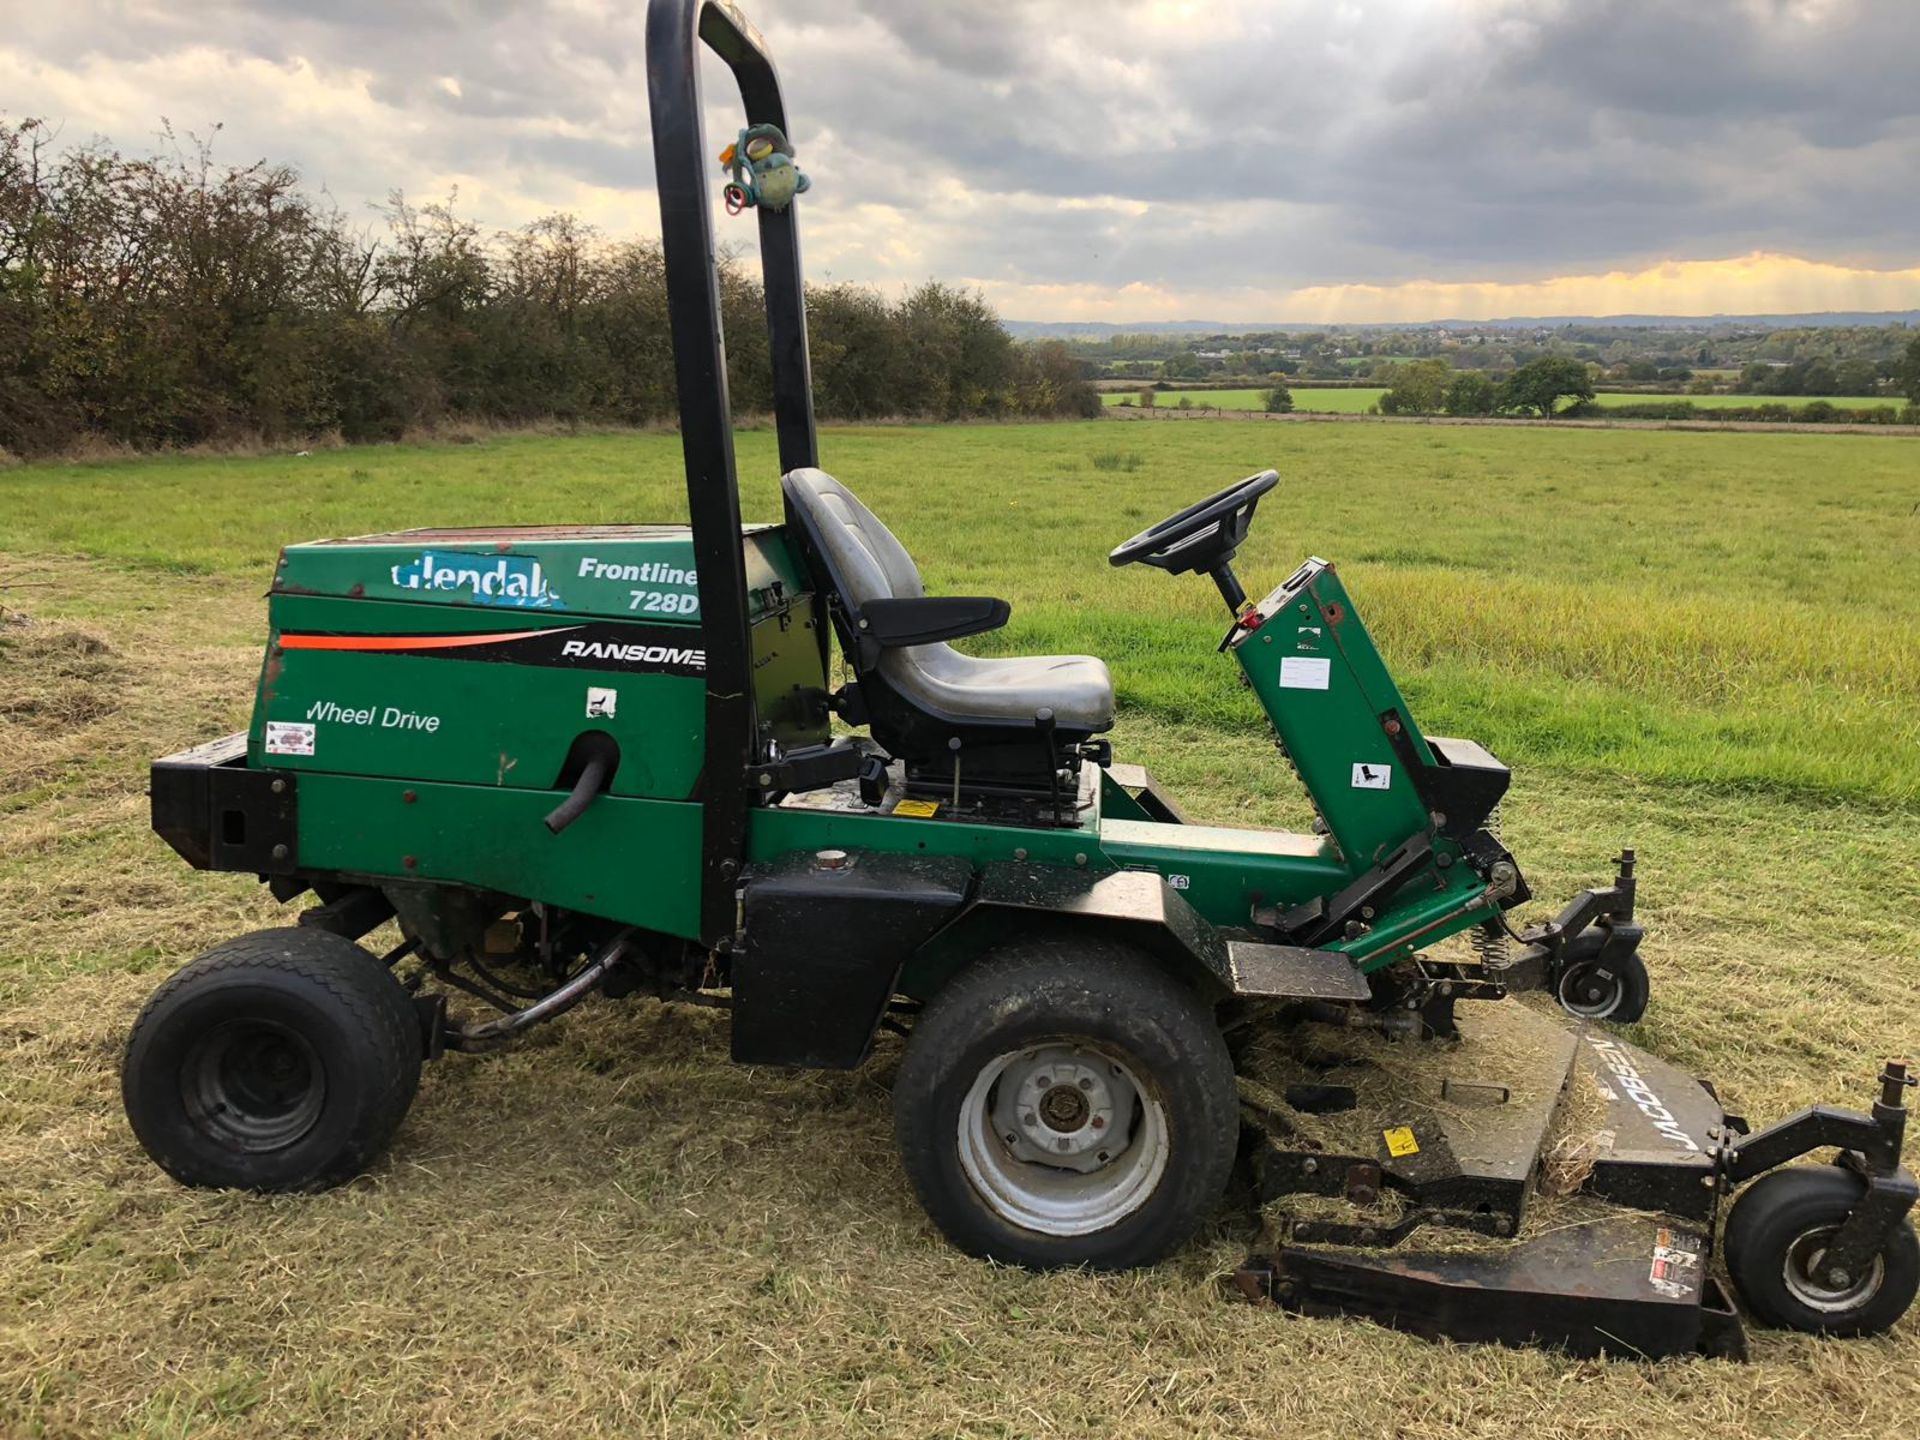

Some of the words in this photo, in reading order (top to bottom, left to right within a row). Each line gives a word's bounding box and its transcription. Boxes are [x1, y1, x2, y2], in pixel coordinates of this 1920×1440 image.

[578, 557, 698, 586] Frontline
[628, 590, 699, 614] 728D
[561, 640, 706, 666] RANSOME
[381, 707, 440, 732] Drive
[1585, 1035, 1700, 1150] JACOBSEN
